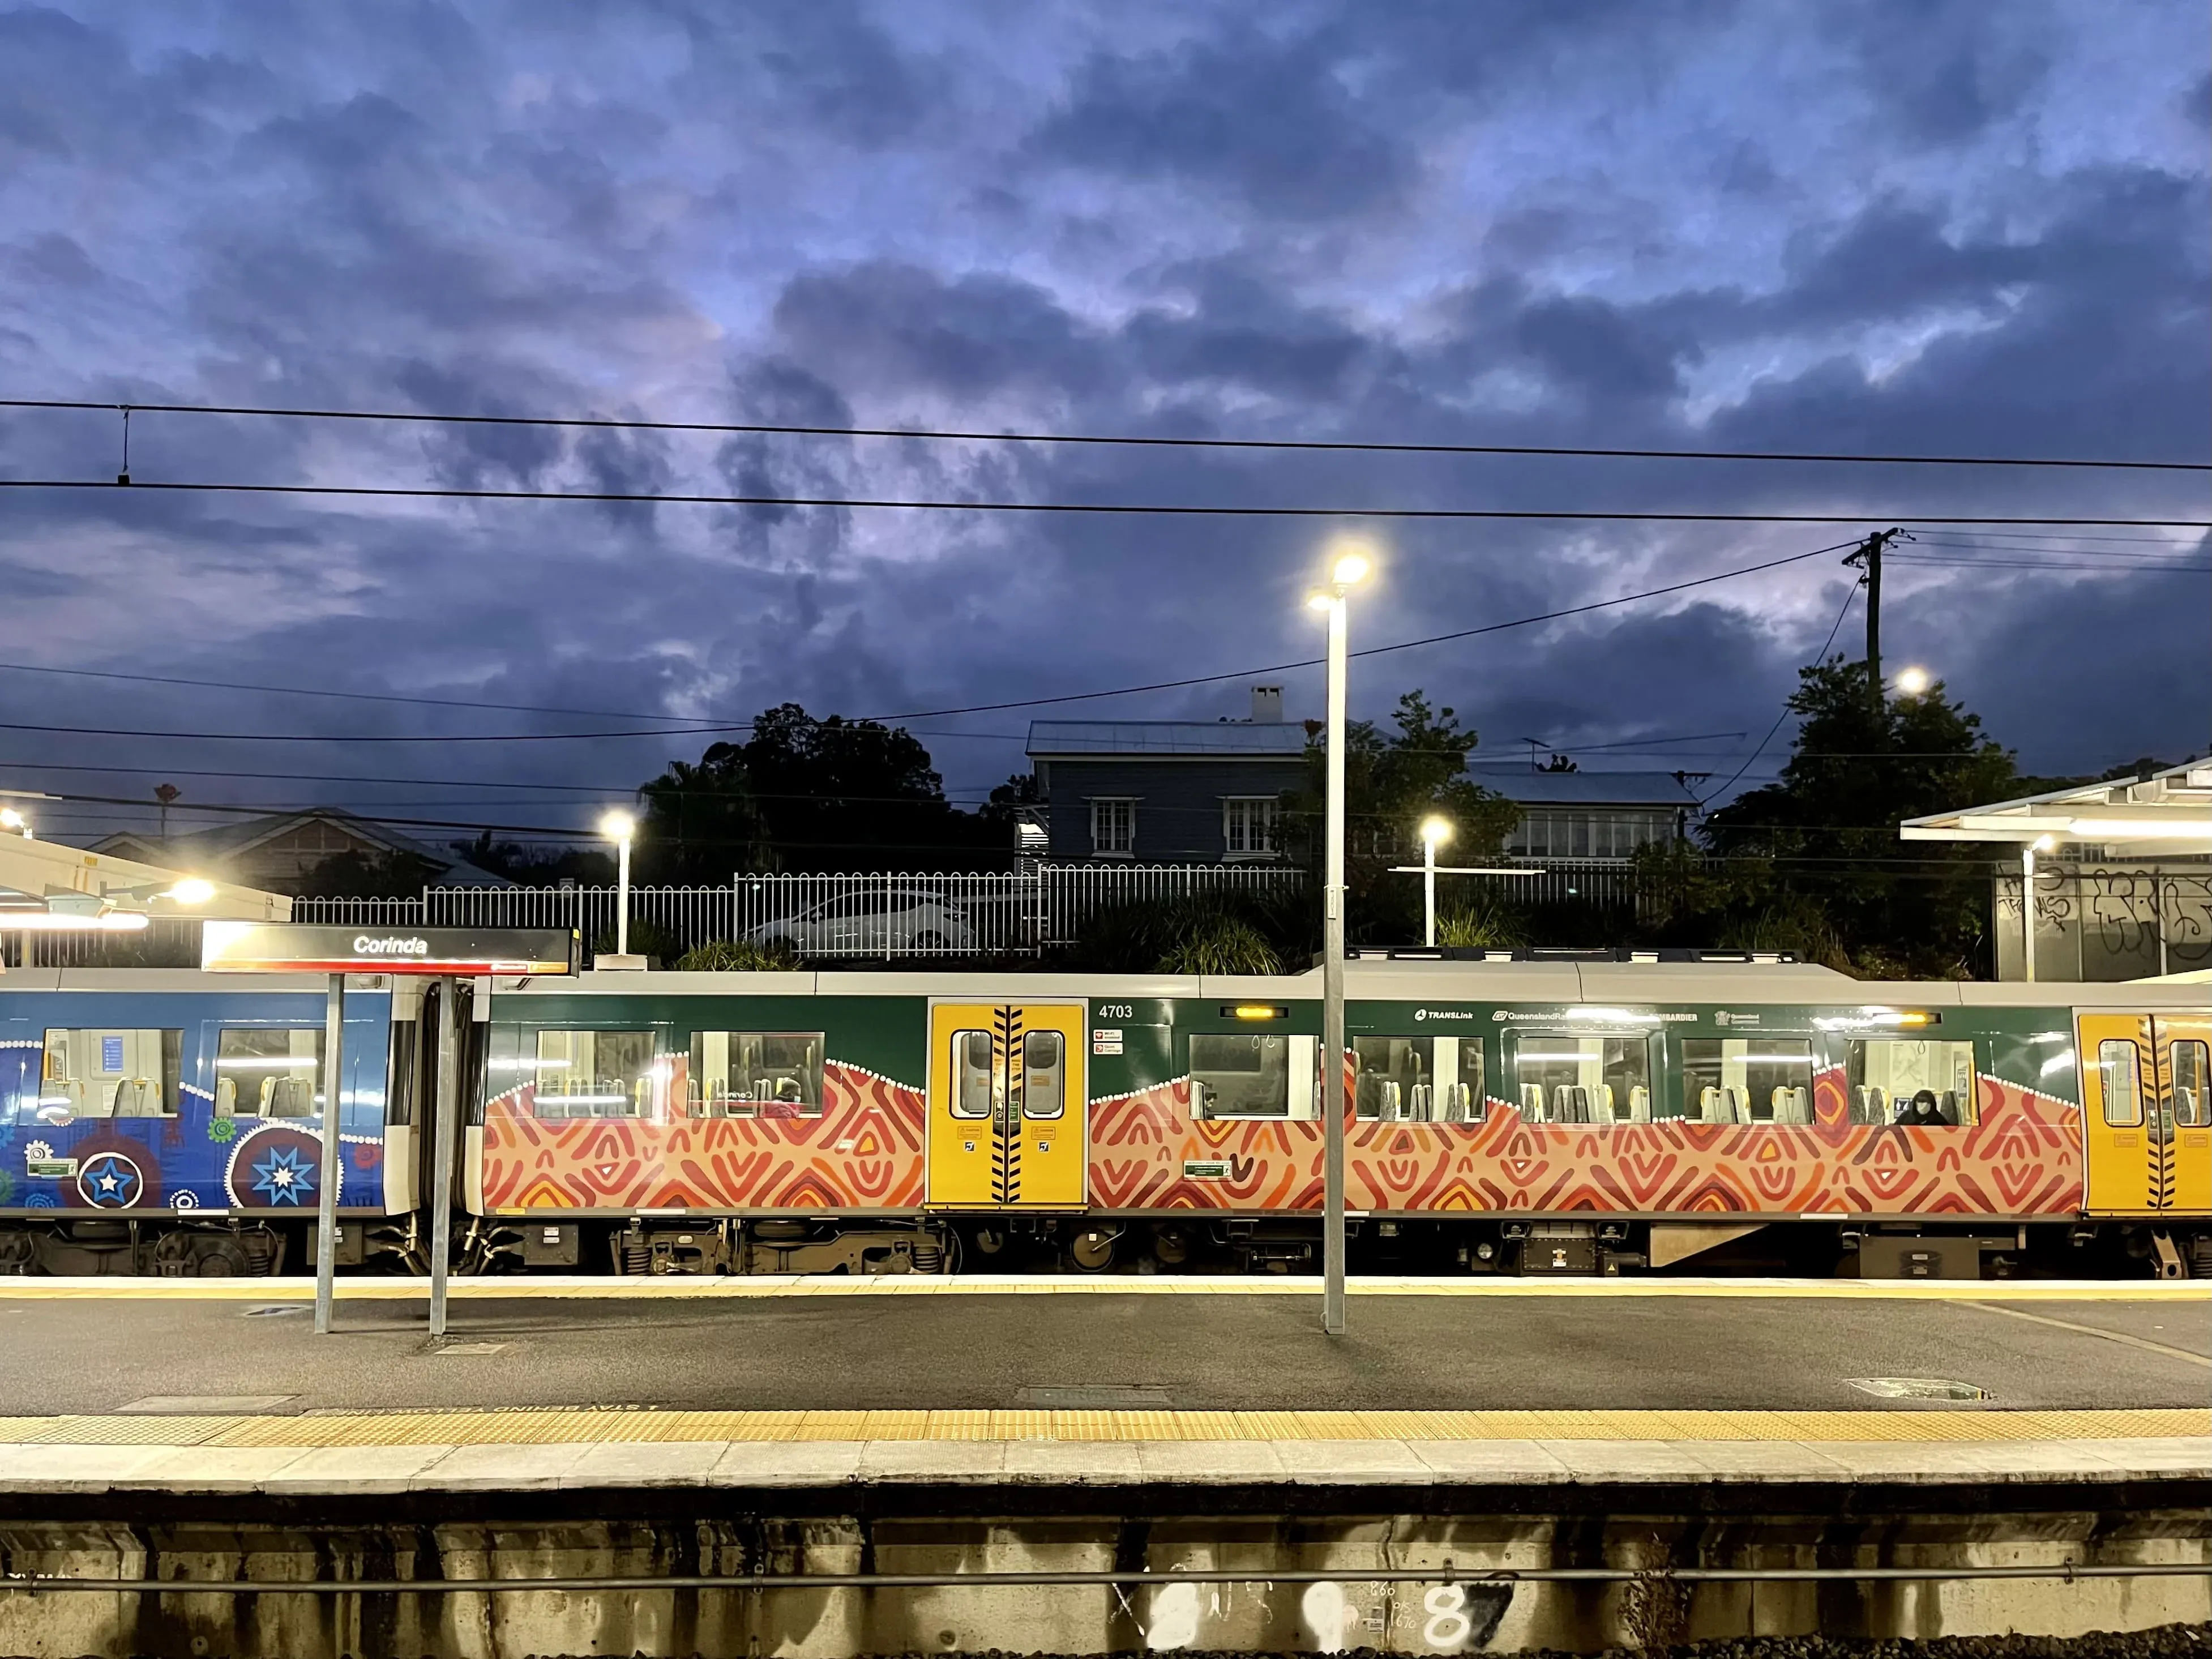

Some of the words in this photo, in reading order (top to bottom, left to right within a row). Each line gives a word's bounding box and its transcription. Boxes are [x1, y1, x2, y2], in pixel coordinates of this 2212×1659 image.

[353, 935, 427, 954] Corinda
[1099, 1005, 1132, 1018] 4703
[1650, 1013, 1697, 1021] MBARDIER
[1371, 1581, 1396, 1596] 860
[1424, 1583, 1470, 1647] 8
